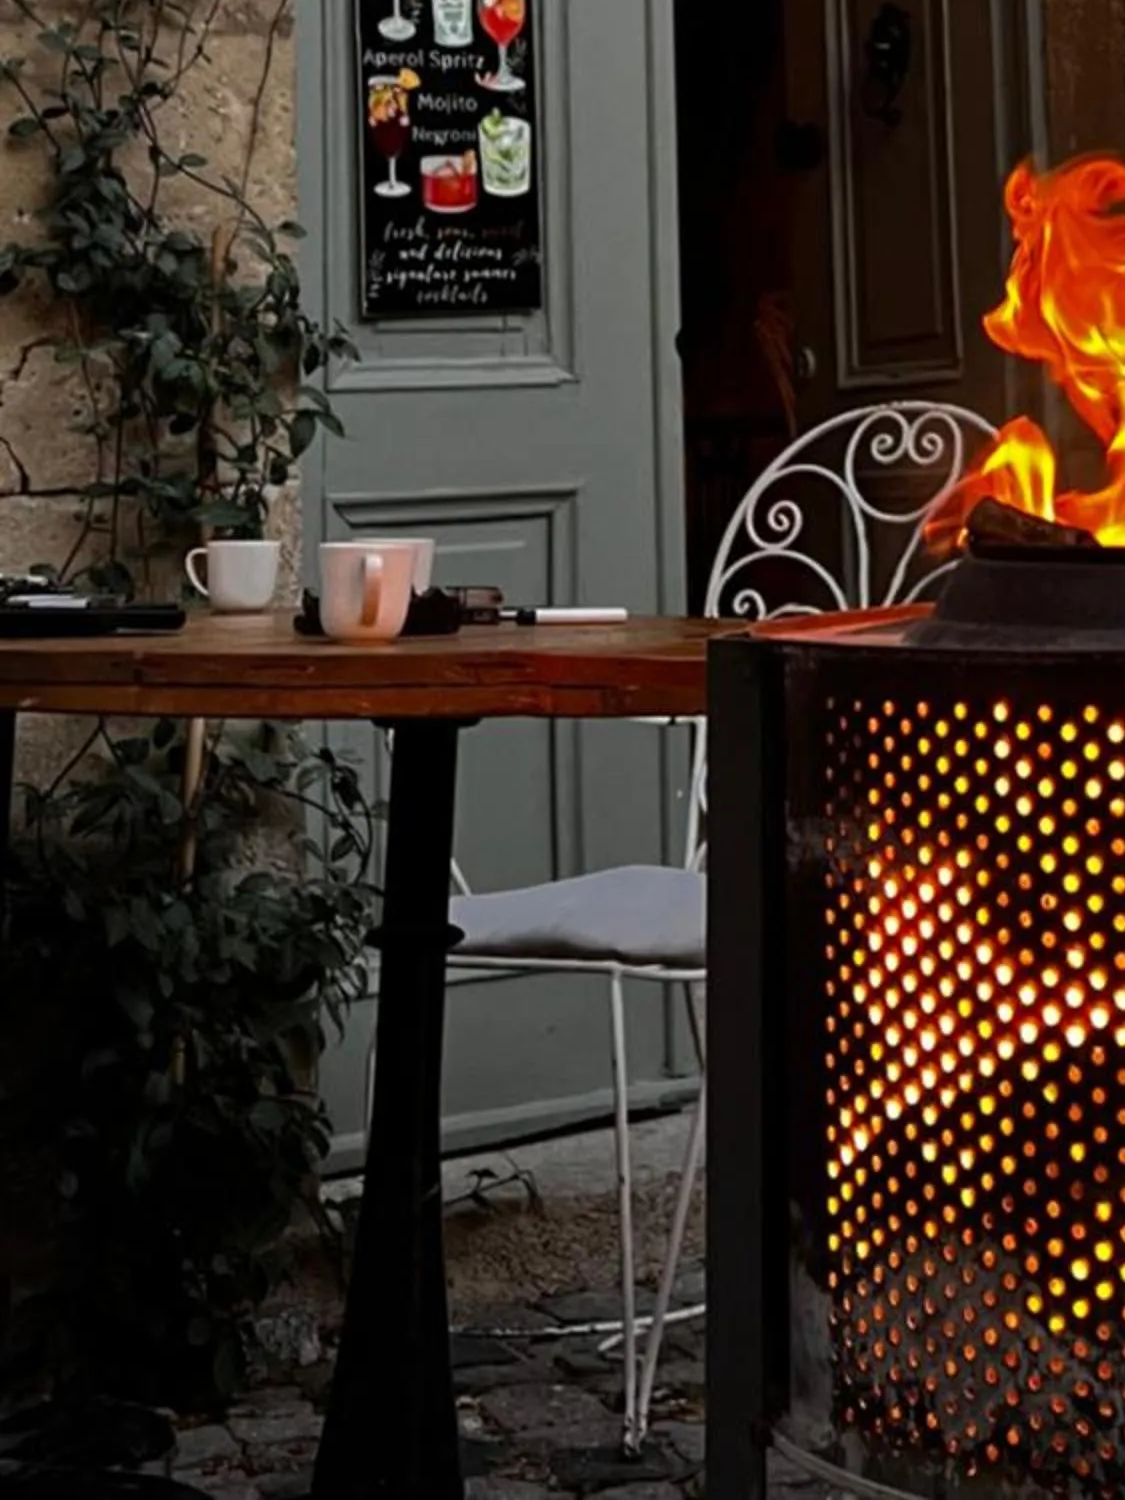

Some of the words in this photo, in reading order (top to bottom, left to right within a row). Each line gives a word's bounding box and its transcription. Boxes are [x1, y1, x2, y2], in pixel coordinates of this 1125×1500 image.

[363, 50, 423, 67] Aperol
[429, 51, 485, 71] Spritz
[417, 93, 478, 113] Mojito
[412, 126, 477, 147] Negroni
